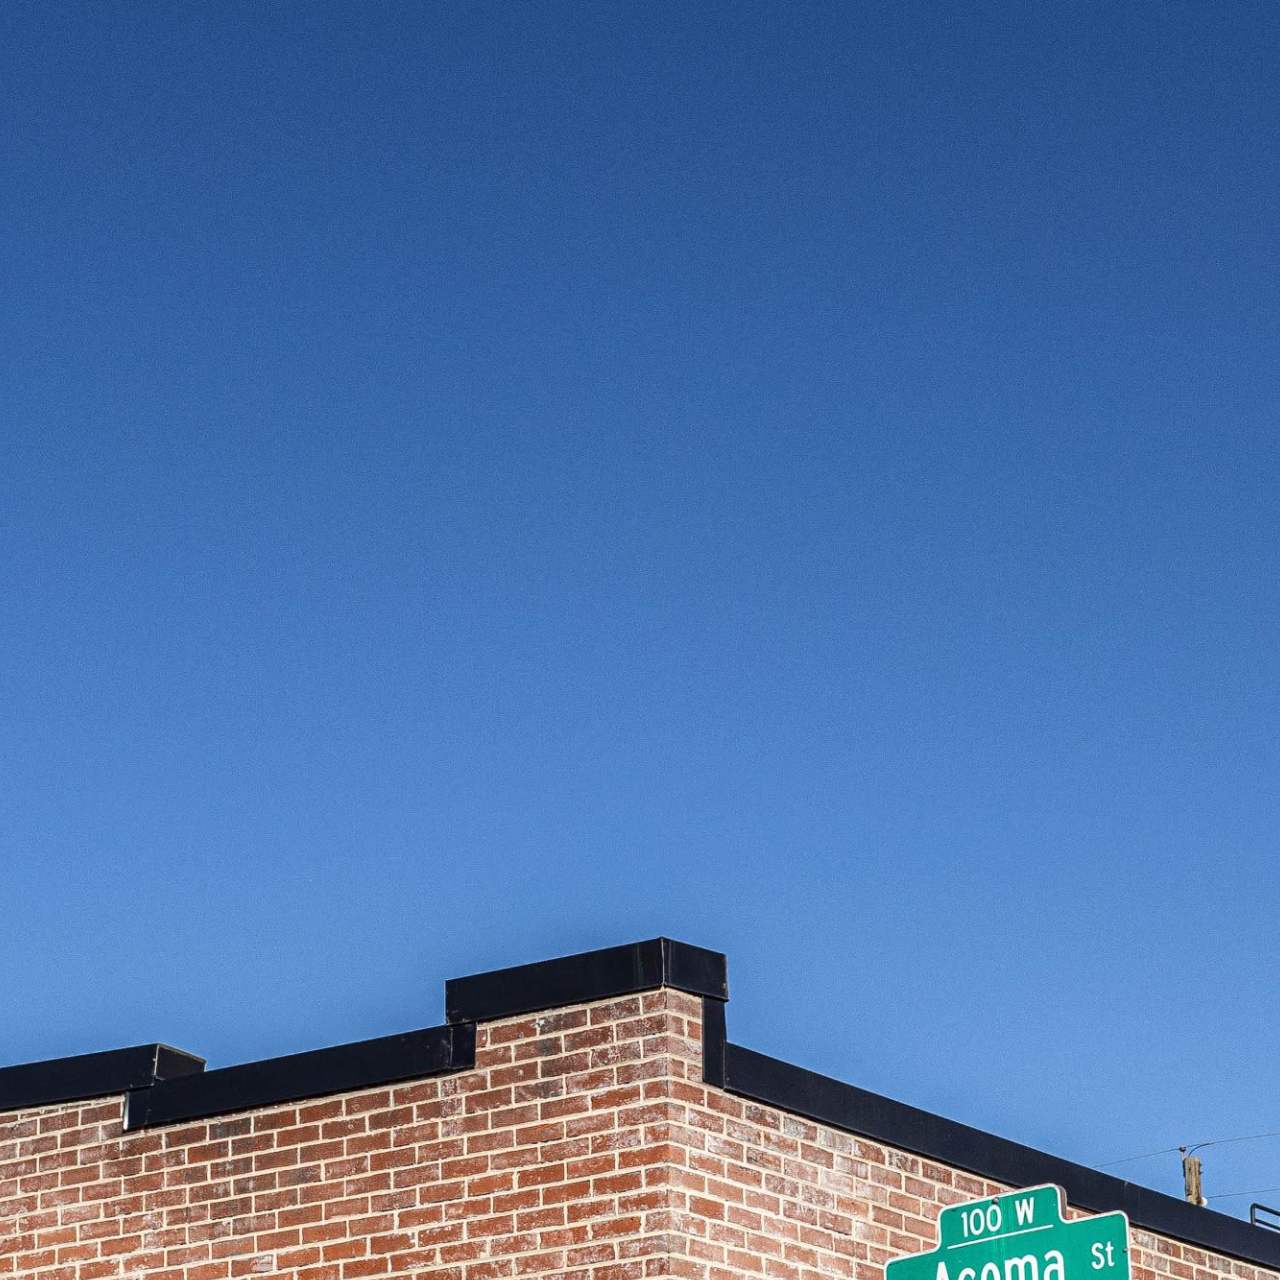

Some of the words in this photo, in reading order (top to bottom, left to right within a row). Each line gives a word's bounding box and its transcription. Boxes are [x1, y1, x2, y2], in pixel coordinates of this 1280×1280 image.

[960, 1205, 1002, 1238] 100
[1015, 1197, 1035, 1226] W
[1091, 1241, 1115, 1270] St
